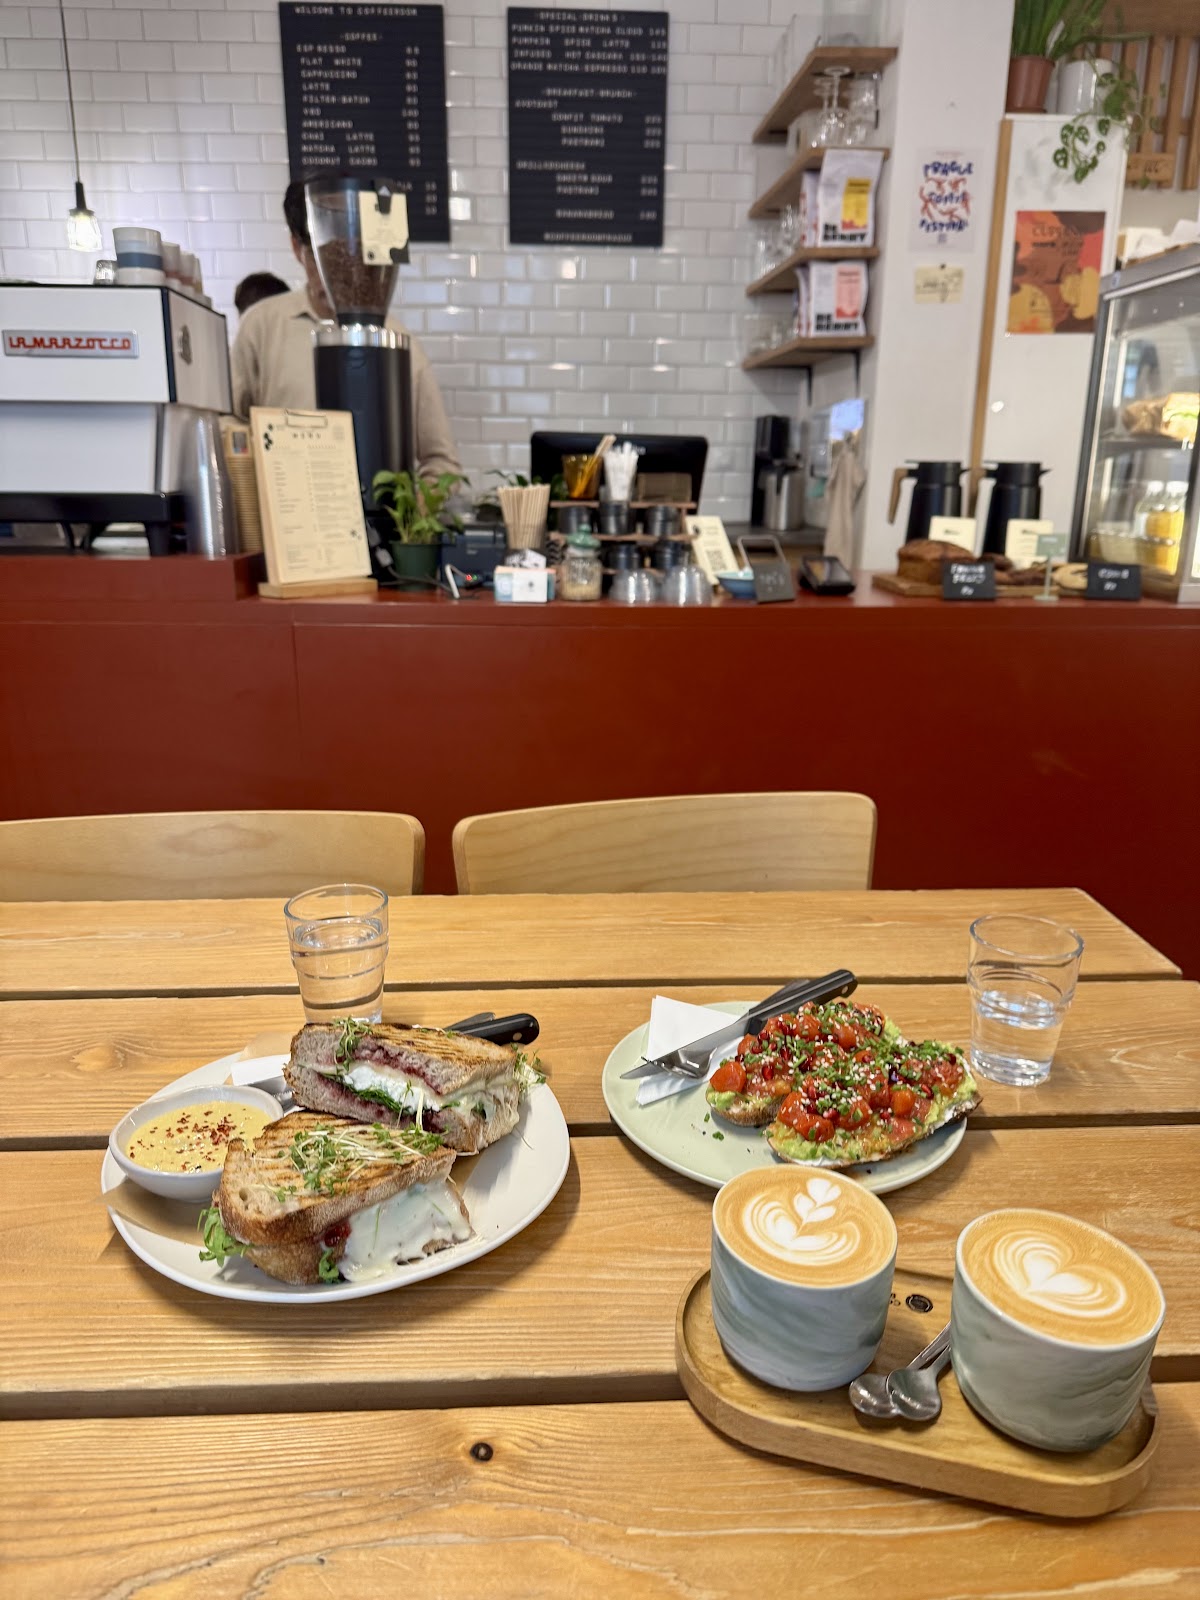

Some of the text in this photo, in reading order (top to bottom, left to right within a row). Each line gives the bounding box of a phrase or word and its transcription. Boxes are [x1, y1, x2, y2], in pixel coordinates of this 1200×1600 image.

[295, 6, 334, 15] WELCOME
[340, 6, 353, 15] TO
[602, 39, 630, 48] LATTE
[300, 57, 323, 66] FLAT
[334, 57, 362, 67] WHITE
[302, 82, 331, 91] LATTE
[301, 119, 353, 129] AMERICANO
[301, 132, 324, 141] CHAI
[345, 131, 375, 142] LATTE
[347, 144, 376, 154] LATTE
